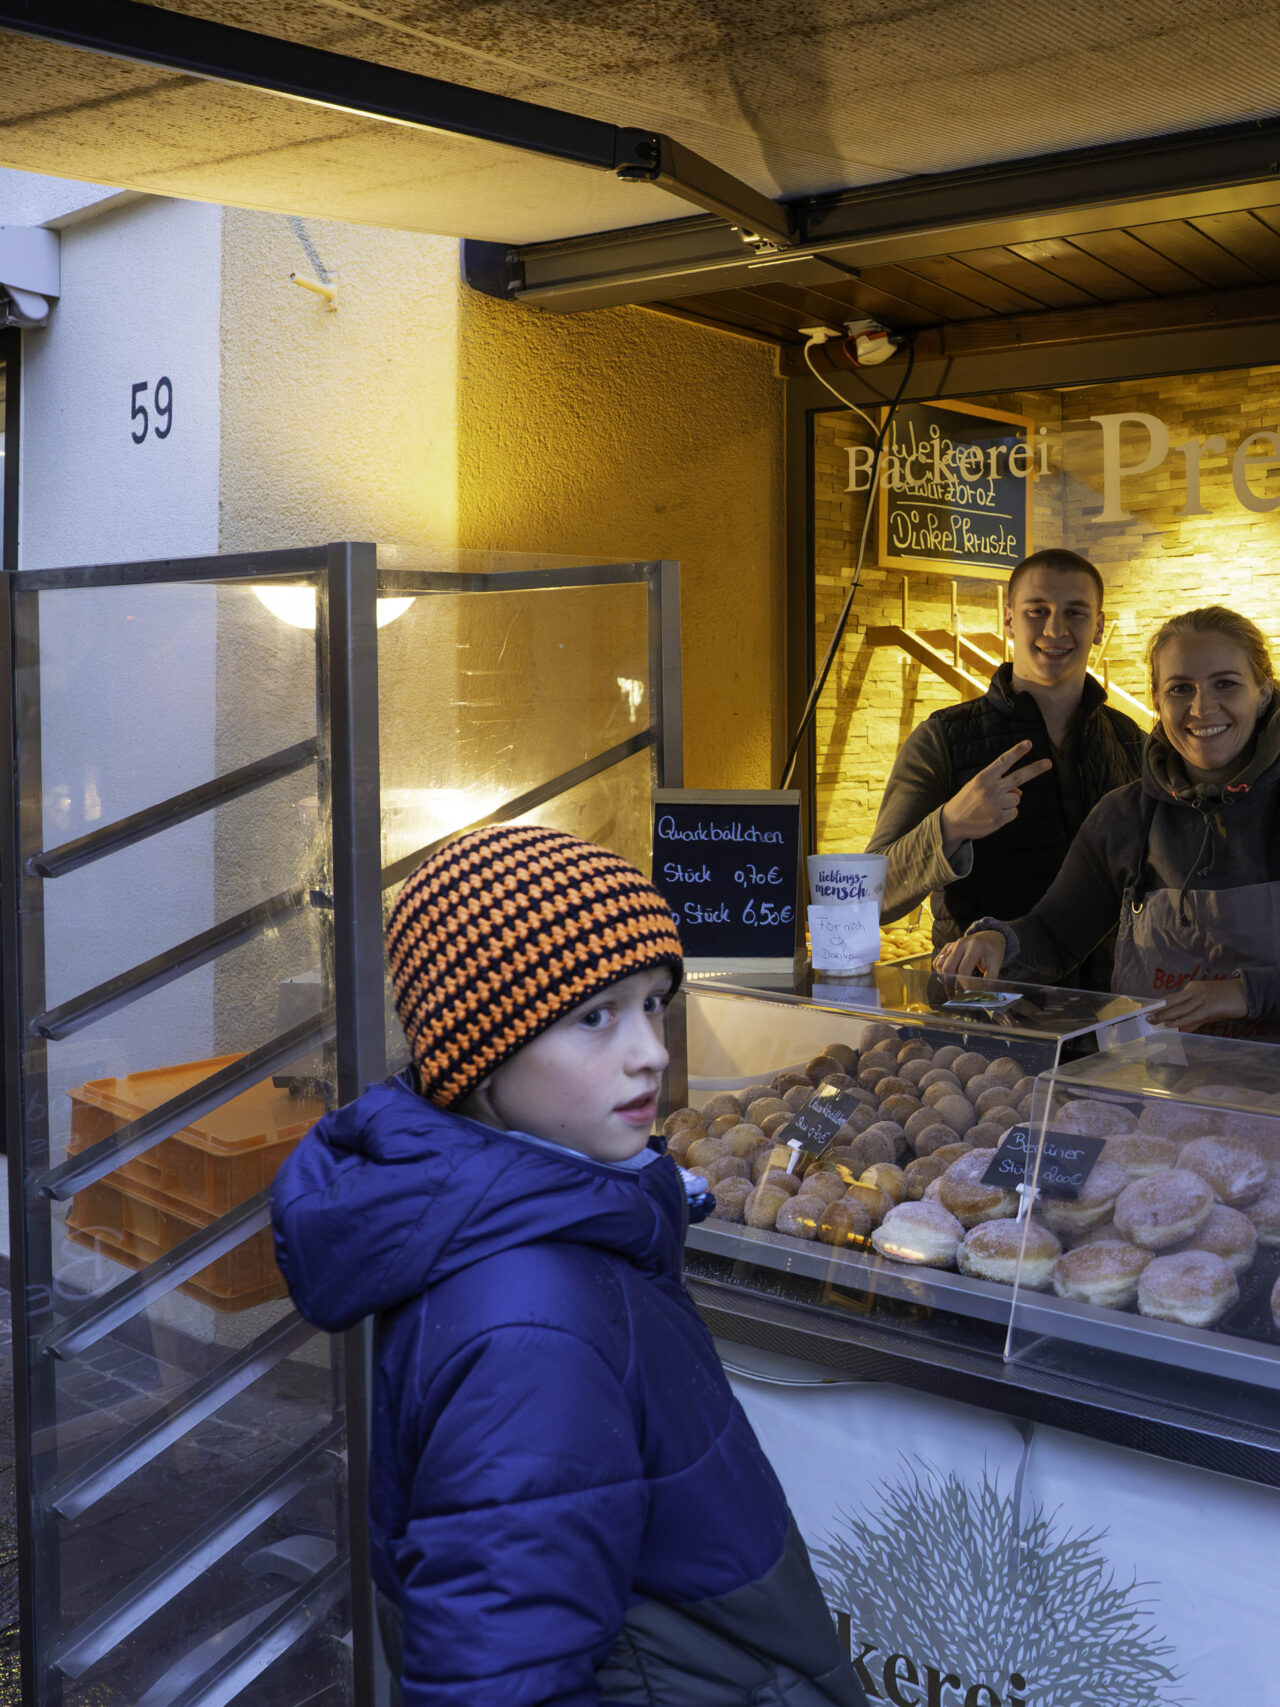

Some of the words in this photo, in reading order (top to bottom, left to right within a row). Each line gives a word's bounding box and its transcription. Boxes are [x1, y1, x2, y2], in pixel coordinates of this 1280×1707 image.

[130, 376, 173, 445] 59
[843, 426, 1052, 493] Bäckerei
[890, 509, 1019, 558] Dinkelkruste
[657, 815, 785, 844] Quarkbällchen
[663, 862, 712, 883] Stück
[684, 901, 731, 924] Stück
[742, 899, 795, 927] 6,50€
